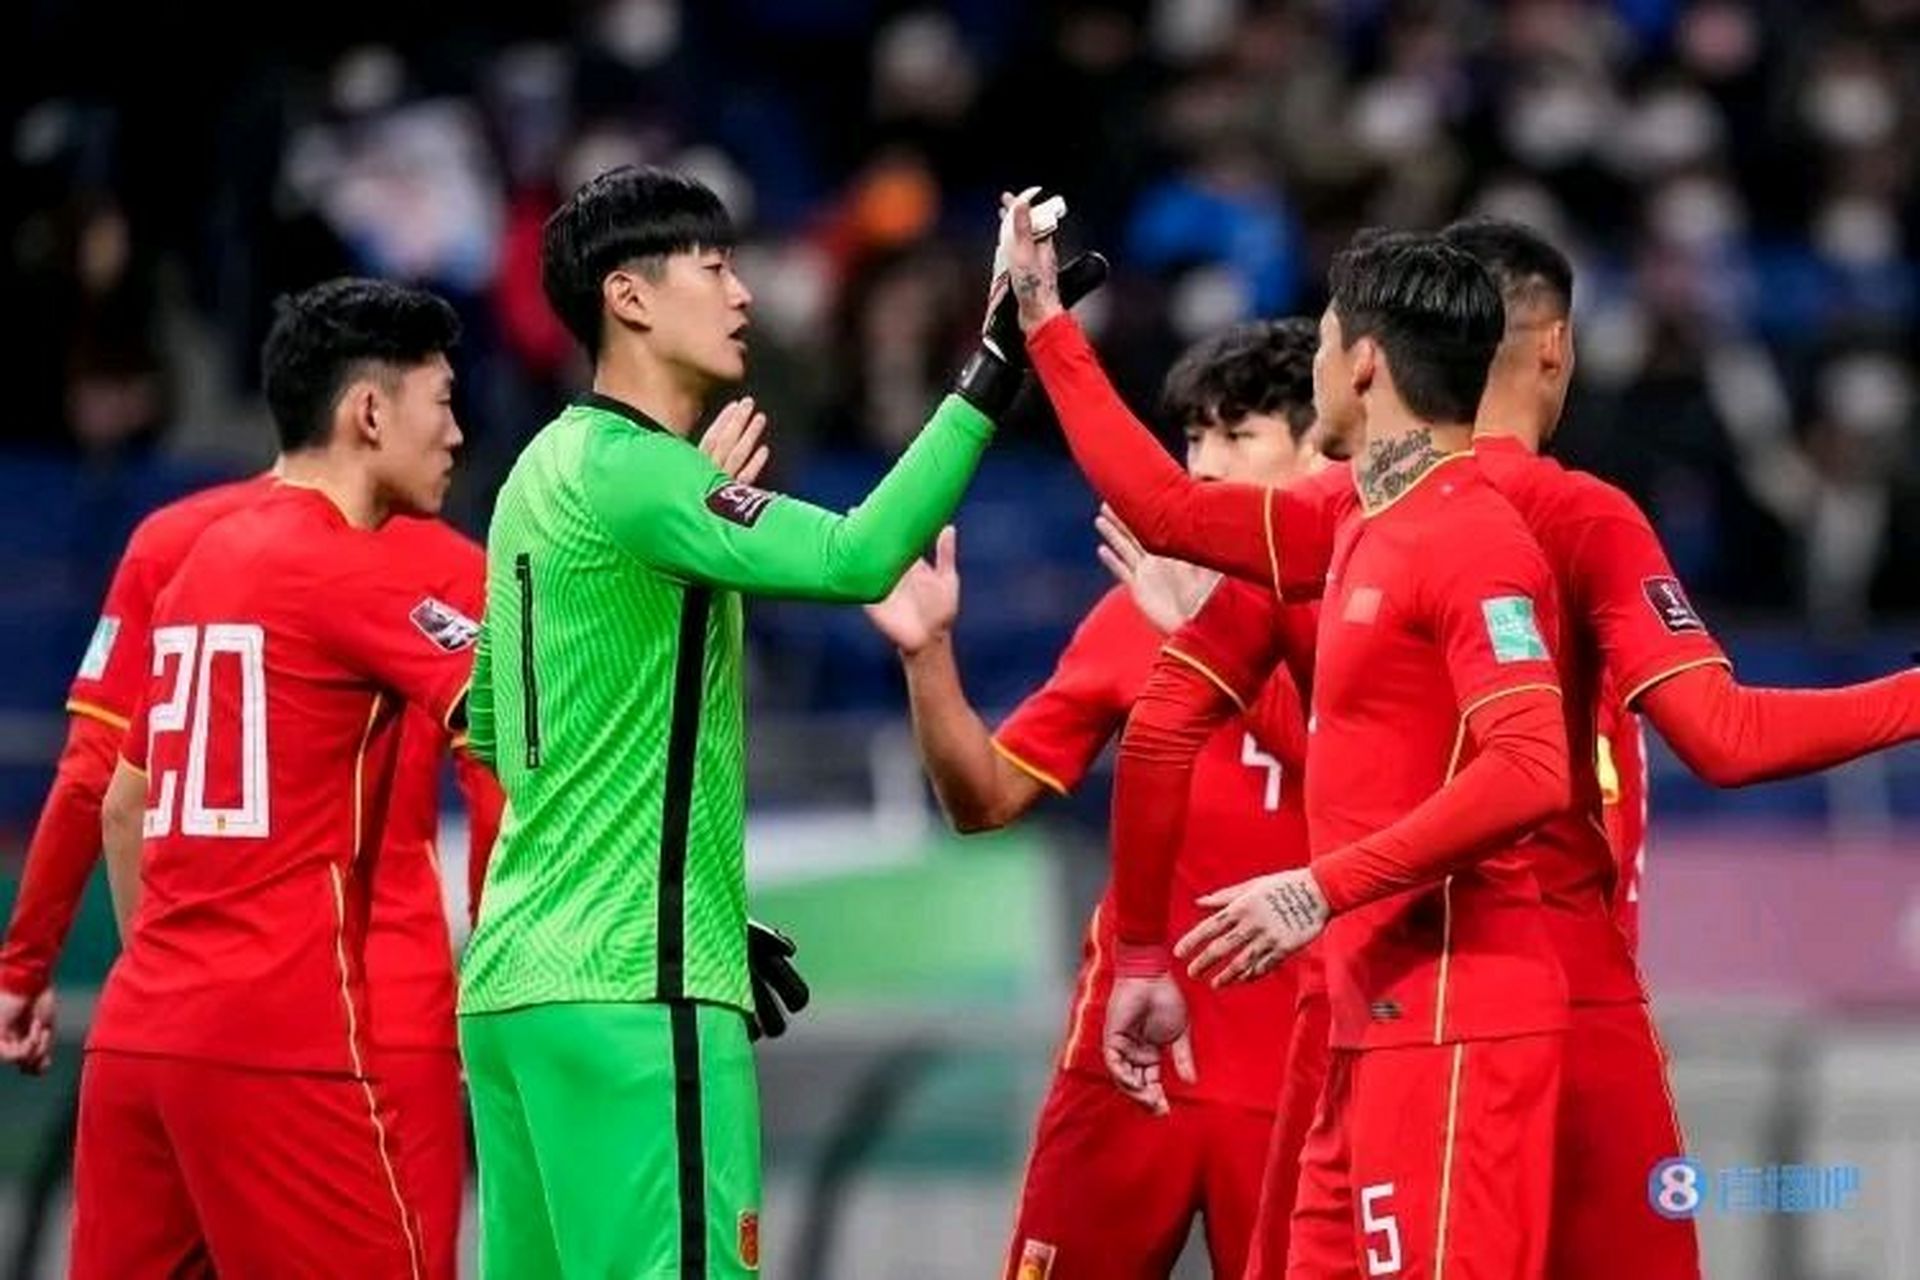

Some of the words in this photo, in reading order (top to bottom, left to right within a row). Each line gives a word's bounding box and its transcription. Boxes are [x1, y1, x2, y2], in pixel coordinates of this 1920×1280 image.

[143, 623, 269, 839] 20
[516, 553, 540, 769] 1
[1361, 1182, 1401, 1276] 5
